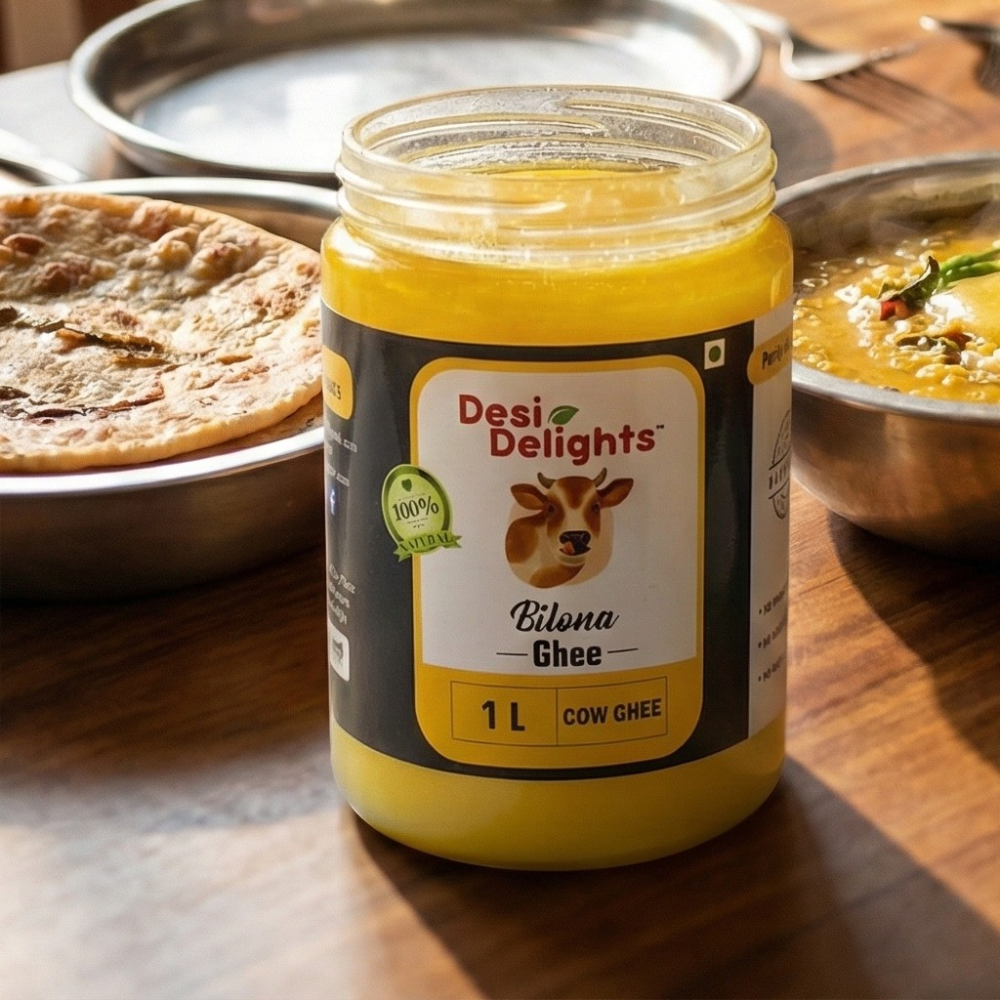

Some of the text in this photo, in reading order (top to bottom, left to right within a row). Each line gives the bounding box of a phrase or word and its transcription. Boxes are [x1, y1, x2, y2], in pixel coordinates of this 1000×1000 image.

[459, 394, 542, 428] Desi
[392, 495, 439, 521] 100%
[510, 599, 620, 632] Bilona
[533, 639, 602, 667] Ghee
[481, 700, 526, 731] 1 L
[563, 698, 663, 726] COW GHEE
